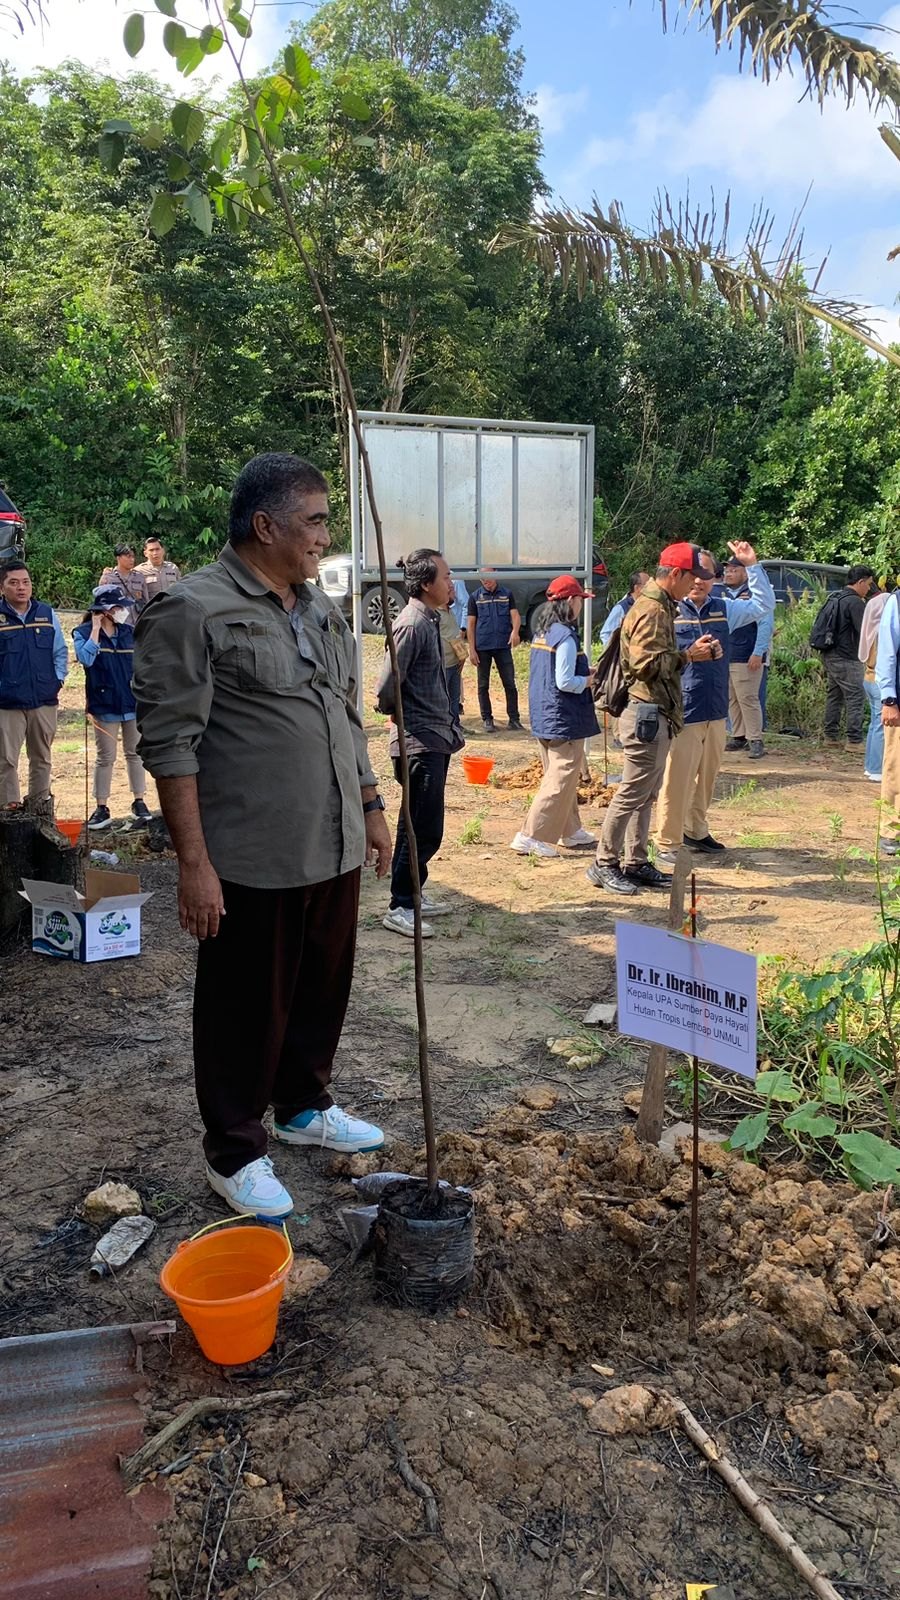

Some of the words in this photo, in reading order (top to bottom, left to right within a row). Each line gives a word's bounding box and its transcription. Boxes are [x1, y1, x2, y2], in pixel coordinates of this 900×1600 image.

[627, 986, 654, 1001] Kepala
[655, 993, 673, 1006] UPA
[673, 998, 703, 1016] Sumber
[704, 1008, 724, 1025] Daya
[725, 1015, 749, 1033] Hayati
[628, 963, 646, 982] Dr.
[649, 968, 663, 986] Ir.
[666, 972, 722, 1007] Ibrahim,
[724, 990, 748, 1013] M.P
[633, 1002, 656, 1017] Hutan
[657, 1009, 681, 1025] Tropis
[682, 1016, 712, 1036] Lembap
[713, 1028, 742, 1047] UNMUL
